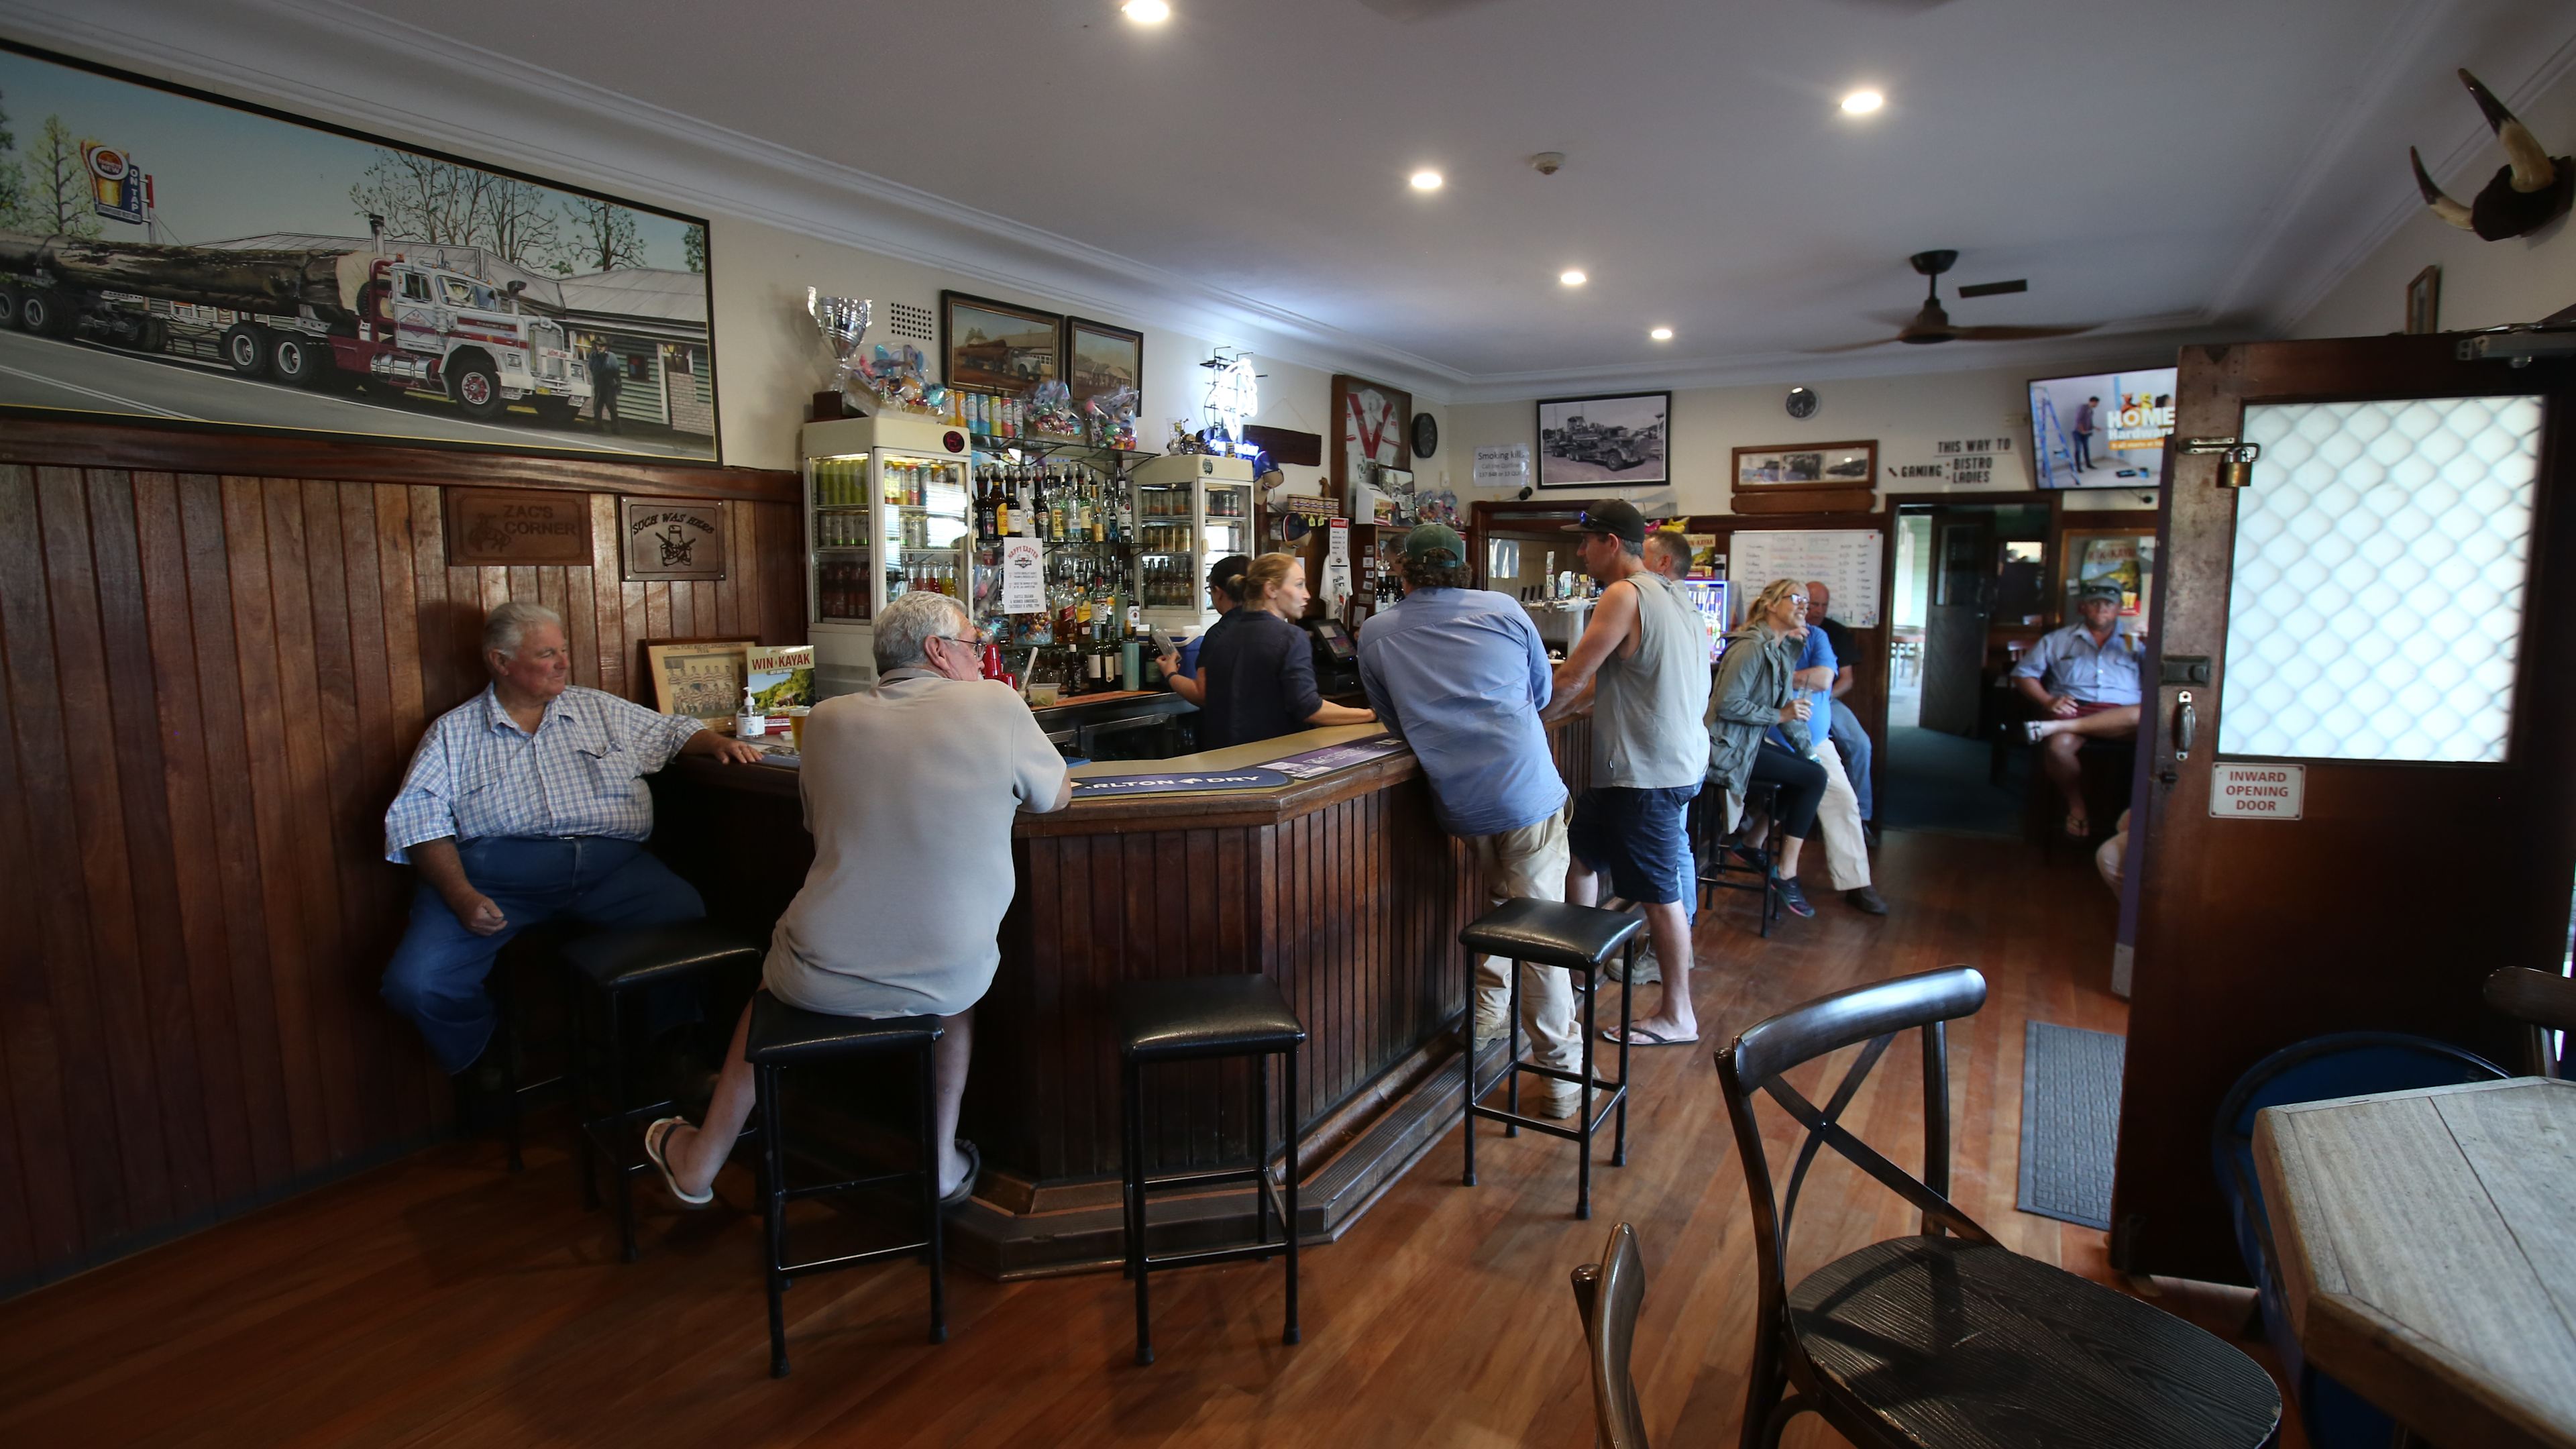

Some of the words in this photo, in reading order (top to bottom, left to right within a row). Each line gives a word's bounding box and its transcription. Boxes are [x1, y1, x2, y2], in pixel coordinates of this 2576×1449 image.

[2107, 407, 2175, 428] HOME
[1938, 441, 1961, 453] THIS
[1966, 439, 1990, 452] WAY
[1998, 438, 2010, 451] TO
[1478, 451, 1509, 460] Smoking
[1511, 450, 1525, 459] kills
[1953, 457, 1992, 470] BISTRO
[1901, 466, 1942, 478] GAMING
[1953, 471, 1990, 484] LADIES
[504, 505, 553, 519] ZAC'S
[504, 521, 576, 535] CORNER
[633, 514, 658, 535] SUCH
[662, 513, 686, 523] WAS
[1008, 546, 1022, 559] HAPPY
[1023, 545, 1038, 559] EASTER
[752, 657, 773, 670] WIN
[779, 653, 810, 667] KAYAK
[2230, 771, 2286, 782] INWARD
[2226, 786, 2288, 798] OPENING
[2237, 800, 2276, 811] DOOR
